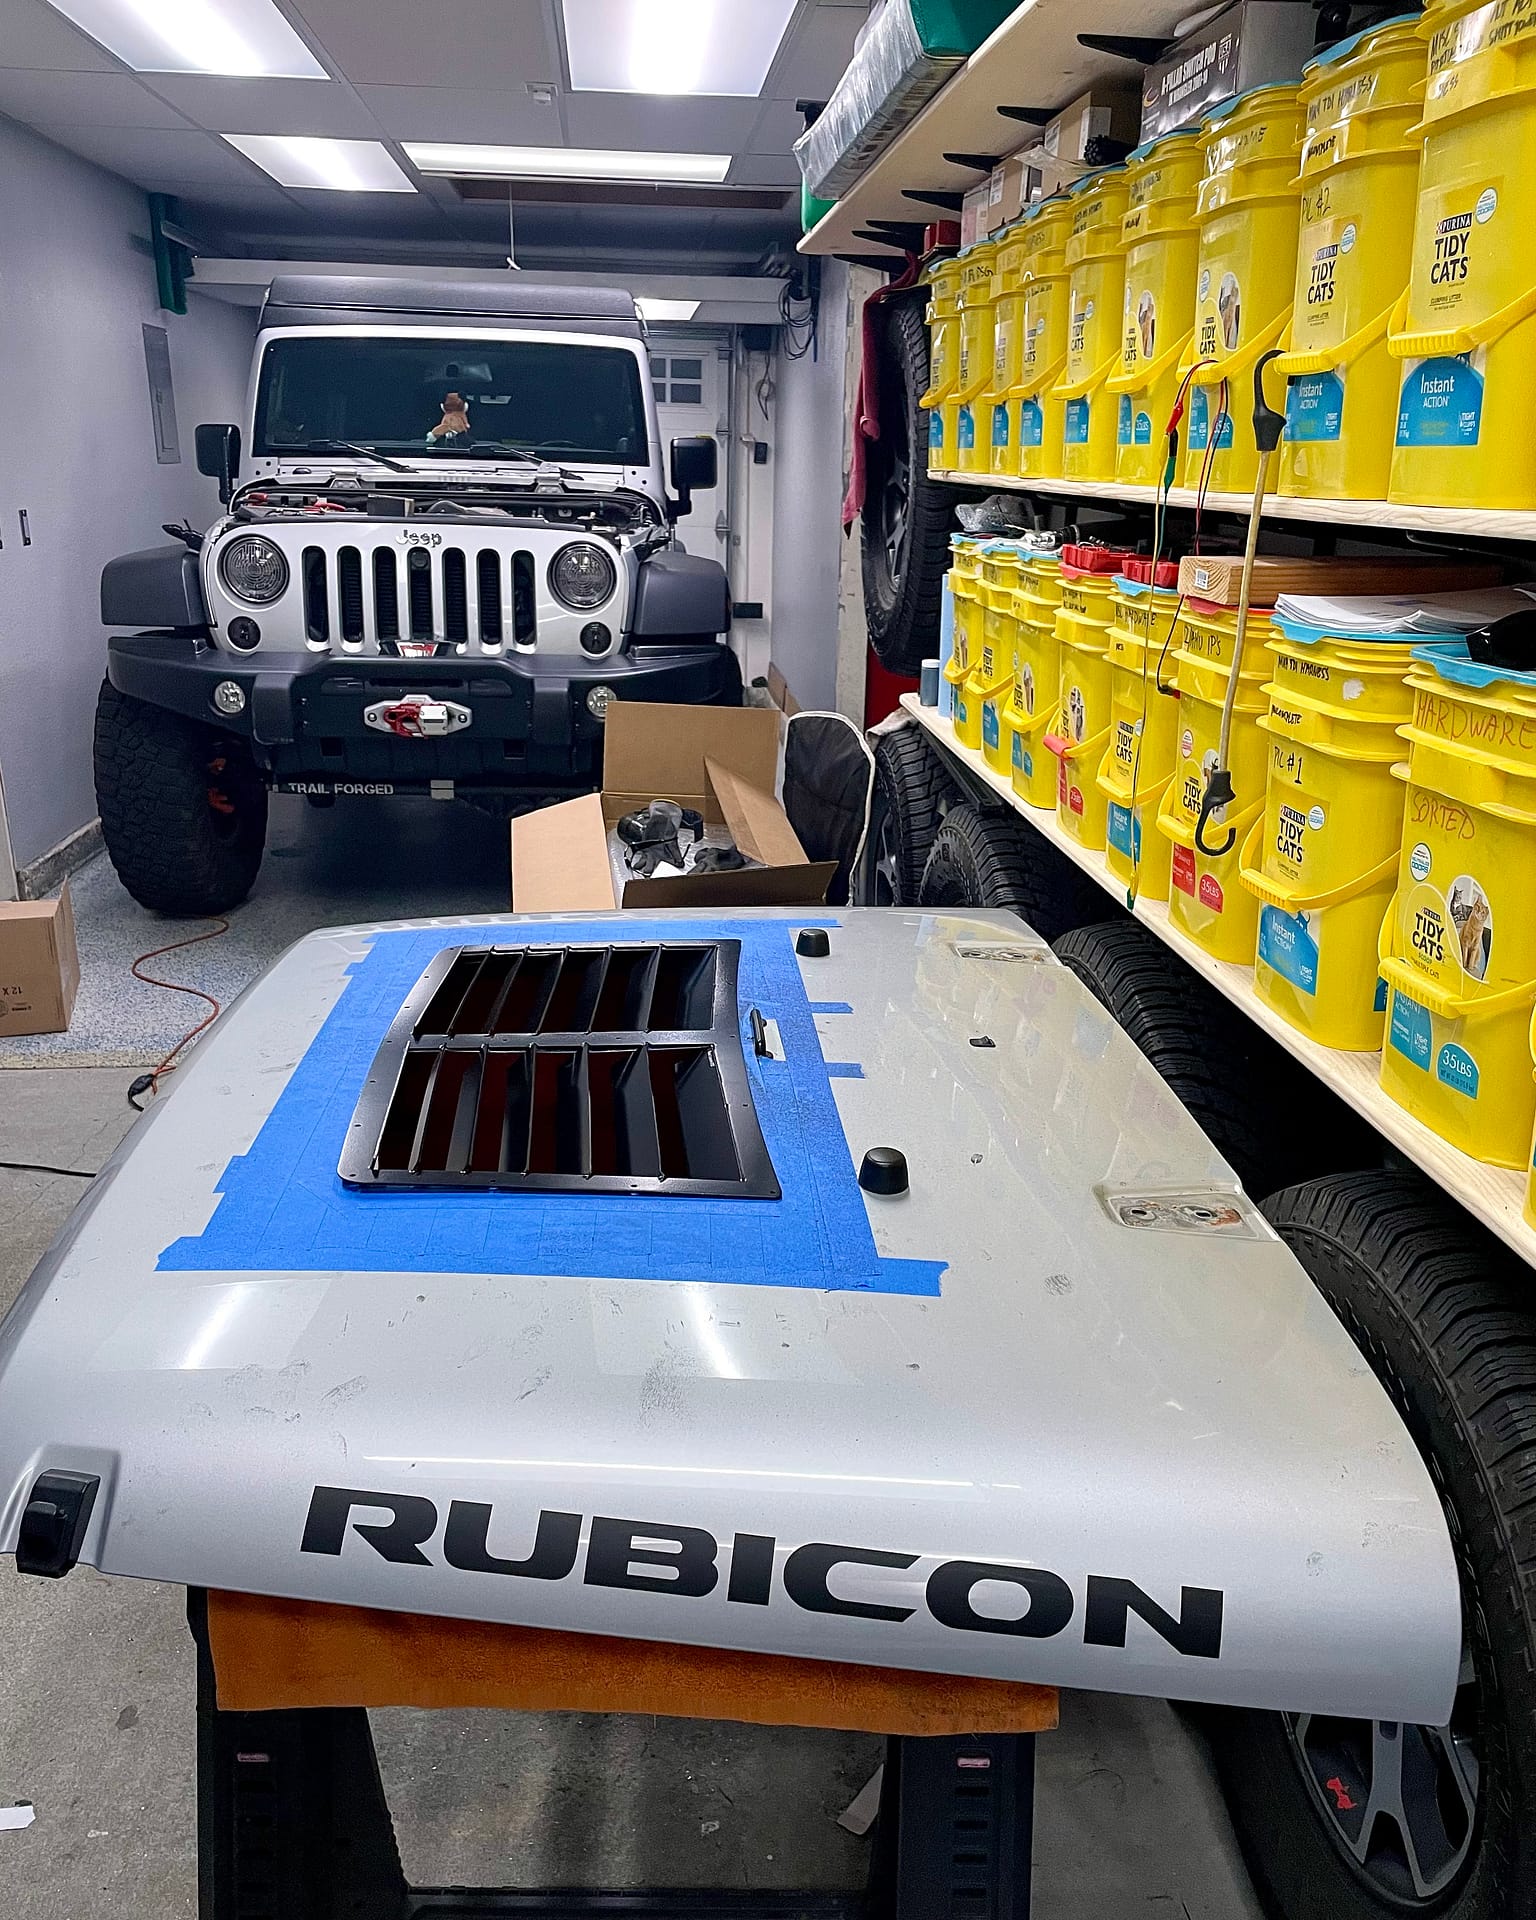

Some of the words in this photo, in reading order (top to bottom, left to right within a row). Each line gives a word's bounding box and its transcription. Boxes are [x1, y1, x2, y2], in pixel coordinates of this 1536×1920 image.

[1441, 213, 1472, 233] PURINA
[1434, 231, 1471, 260] TIDY
[1312, 260, 1336, 284] TIDY
[1430, 256, 1469, 285] CATS
[1308, 281, 1335, 304] CATS
[1201, 324, 1217, 340] TIDY
[1124, 349, 1137, 362] CATS
[1199, 340, 1216, 355] CATS
[1299, 382, 1323, 398] Instant
[1420, 373, 1455, 394] Instant
[1423, 396, 1449, 408] ACTION
[396, 529, 442, 548] Jeep
[1300, 661, 1330, 681] HARNESS
[1416, 693, 1536, 749] HARDWARE
[1117, 730, 1133, 748] TIDY
[1115, 744, 1133, 763] CATS
[1287, 752, 1303, 785] #1
[288, 783, 330, 794] TRAIL
[334, 783, 394, 795] FORGED
[1184, 781, 1201, 800] TIDY
[1182, 795, 1201, 814] CATS
[1411, 791, 1475, 840] SORTED
[1279, 816, 1304, 844] TIDY
[1277, 835, 1304, 863] CATS
[1201, 878, 1220, 899] 35LBS
[1272, 914, 1296, 945] Instant
[1415, 912, 1445, 943] TIDY
[1412, 930, 1444, 962] CATS
[1442, 1049, 1473, 1079] 35LBS
[299, 1485, 1225, 1660] RUBICON
